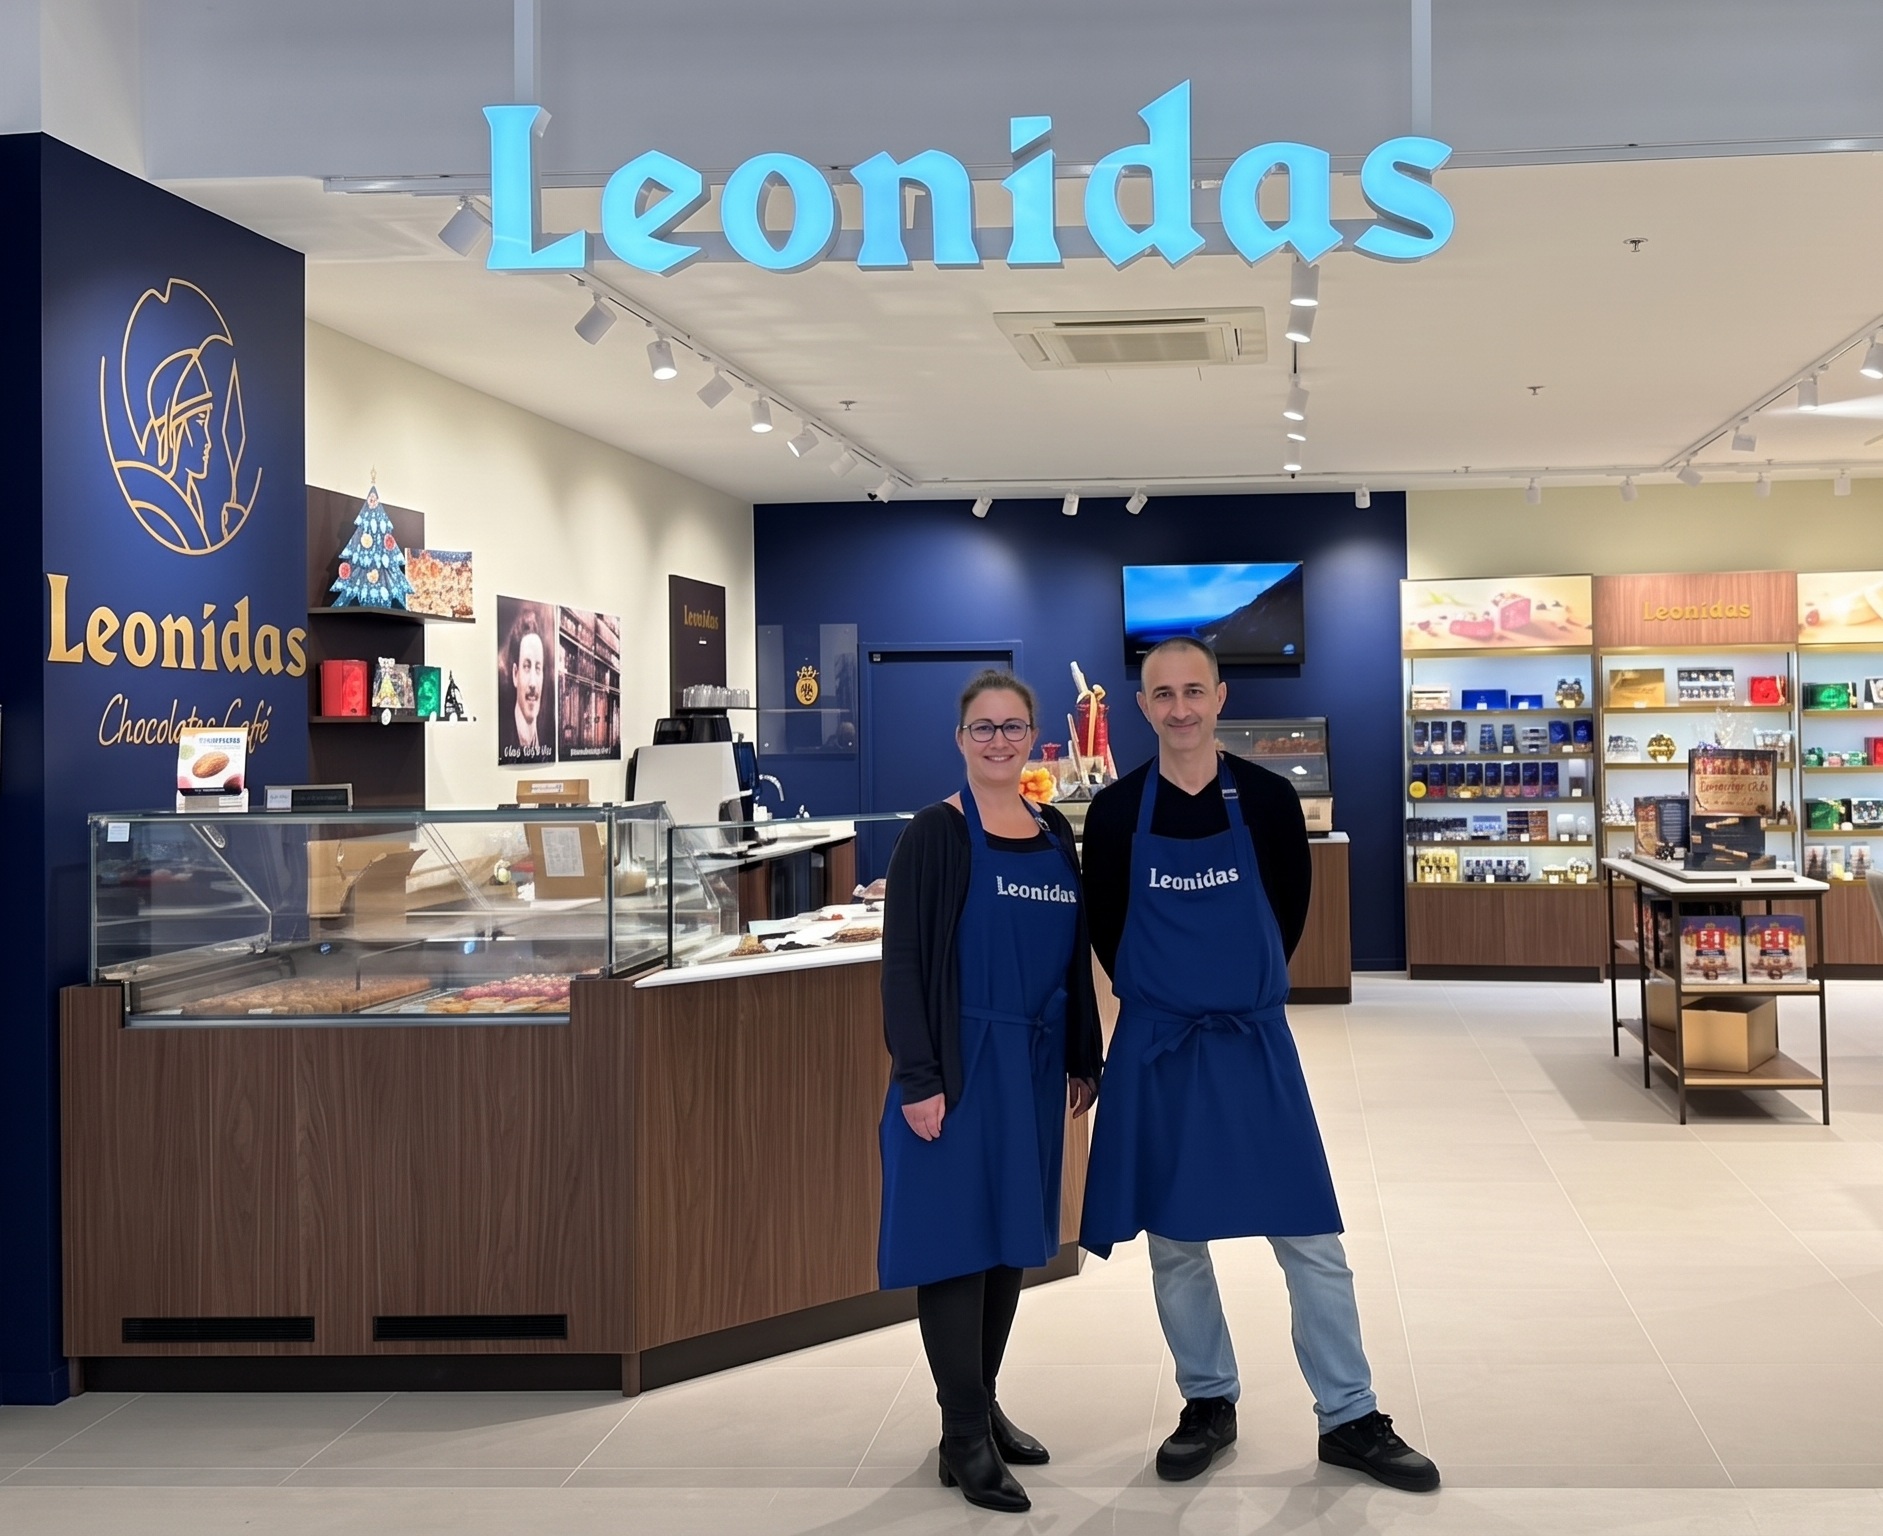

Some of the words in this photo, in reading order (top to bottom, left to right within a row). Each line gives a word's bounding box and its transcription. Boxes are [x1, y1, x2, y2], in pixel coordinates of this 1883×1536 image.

[482, 79, 1455, 272] Leonidas
[46, 573, 307, 677] Leonidas
[1643, 601, 1751, 621] Leonidas
[996, 875, 1077, 903] Leonidas
[1149, 867, 1239, 891] Leonidas
